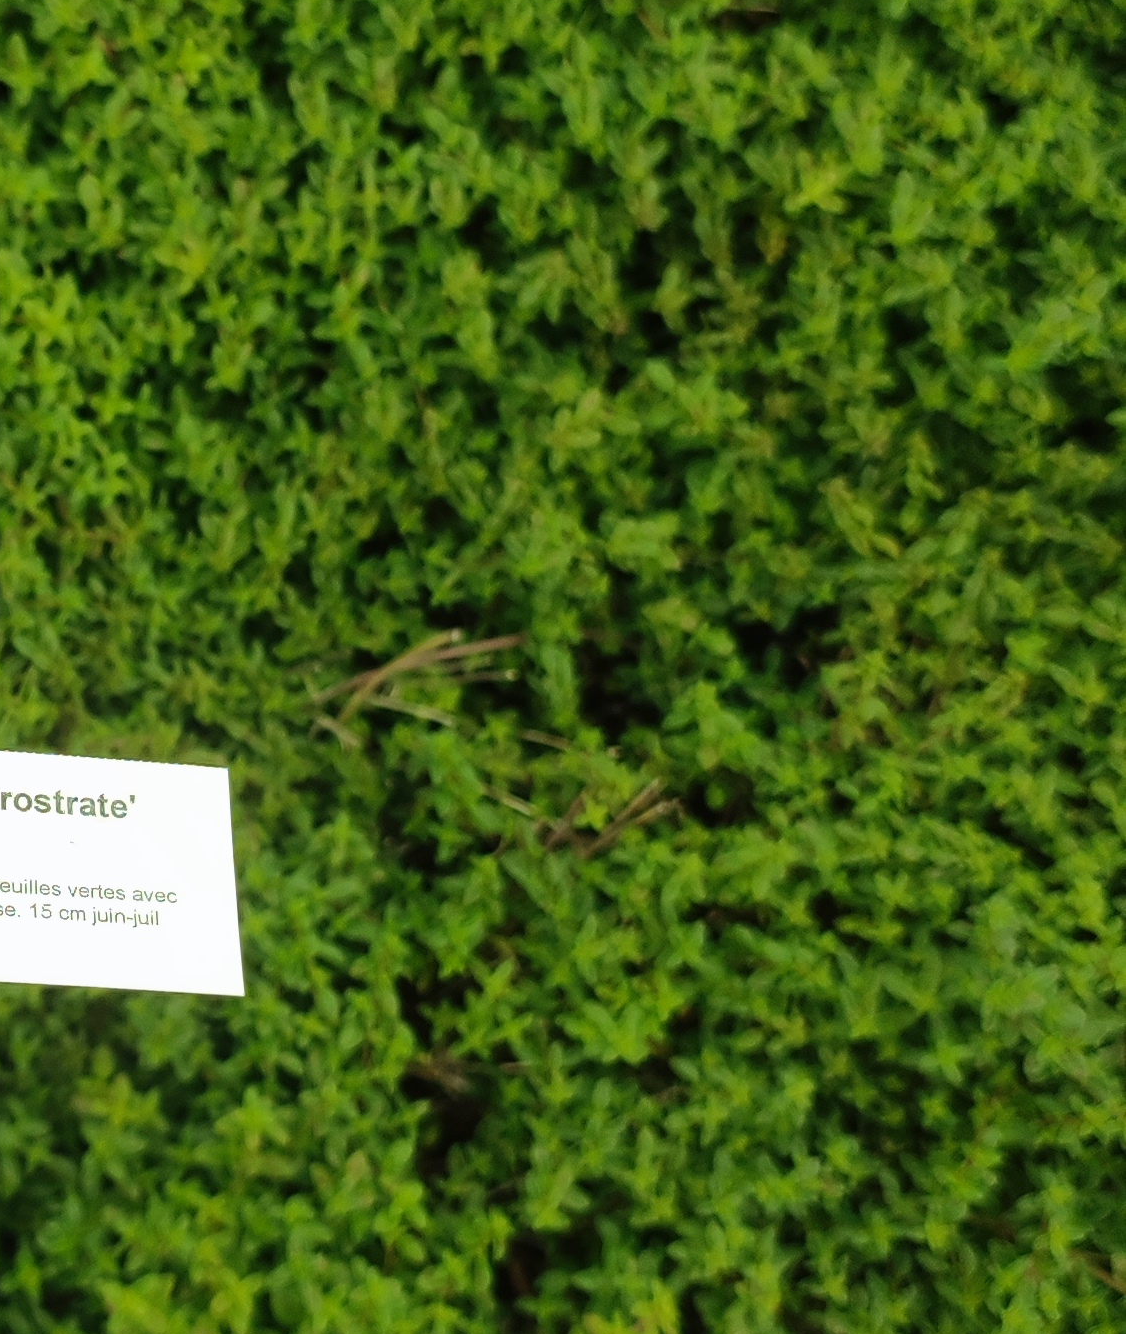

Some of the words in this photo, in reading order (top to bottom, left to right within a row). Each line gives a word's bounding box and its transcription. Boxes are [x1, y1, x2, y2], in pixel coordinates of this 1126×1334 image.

[68, 885, 125, 900] vertes
[133, 890, 177, 903] avec
[30, 903, 52, 919] 15
[59, 909, 86, 921] cm
[92, 907, 158, 928] juin-juil
